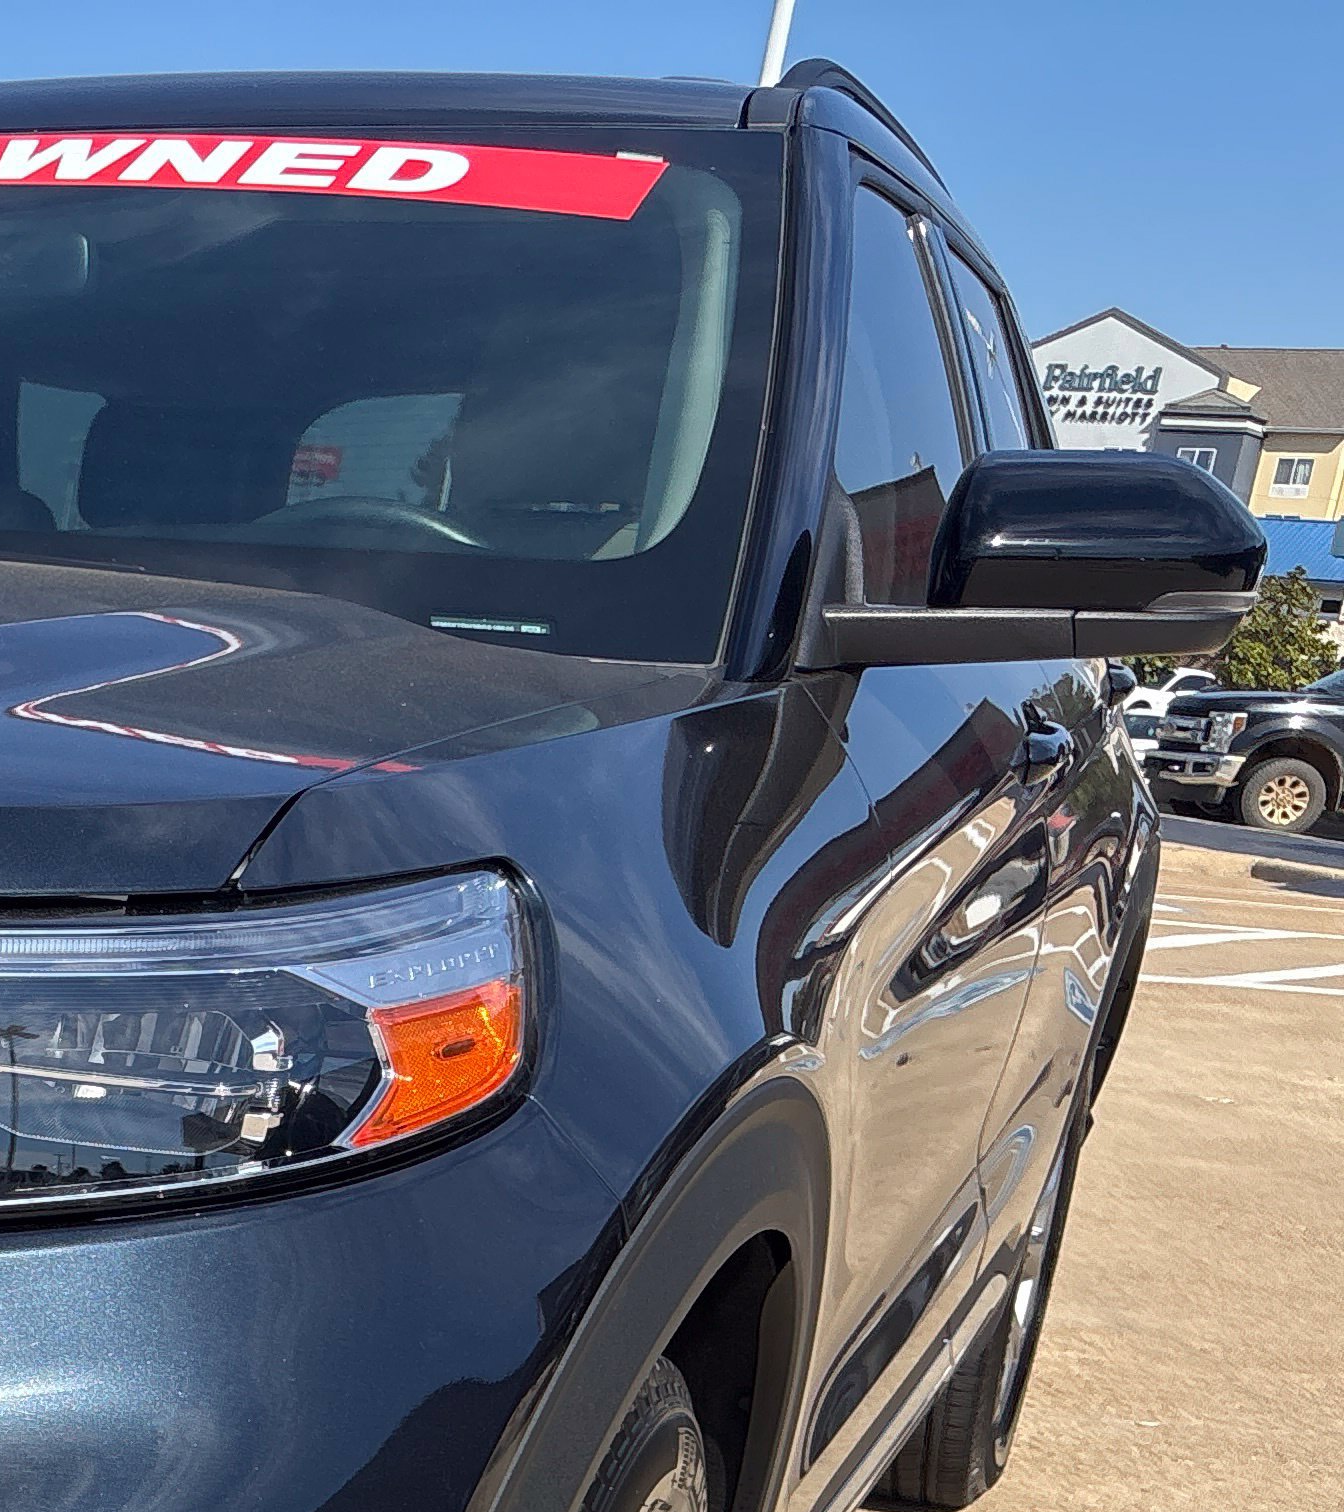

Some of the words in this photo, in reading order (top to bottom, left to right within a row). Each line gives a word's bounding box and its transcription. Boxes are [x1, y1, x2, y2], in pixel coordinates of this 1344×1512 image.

[1043, 363, 1162, 395] Fairfield
[1046, 394, 1072, 408] NN
[1092, 395, 1155, 411] SUITES
[1062, 409, 1151, 426] MARRIOTT
